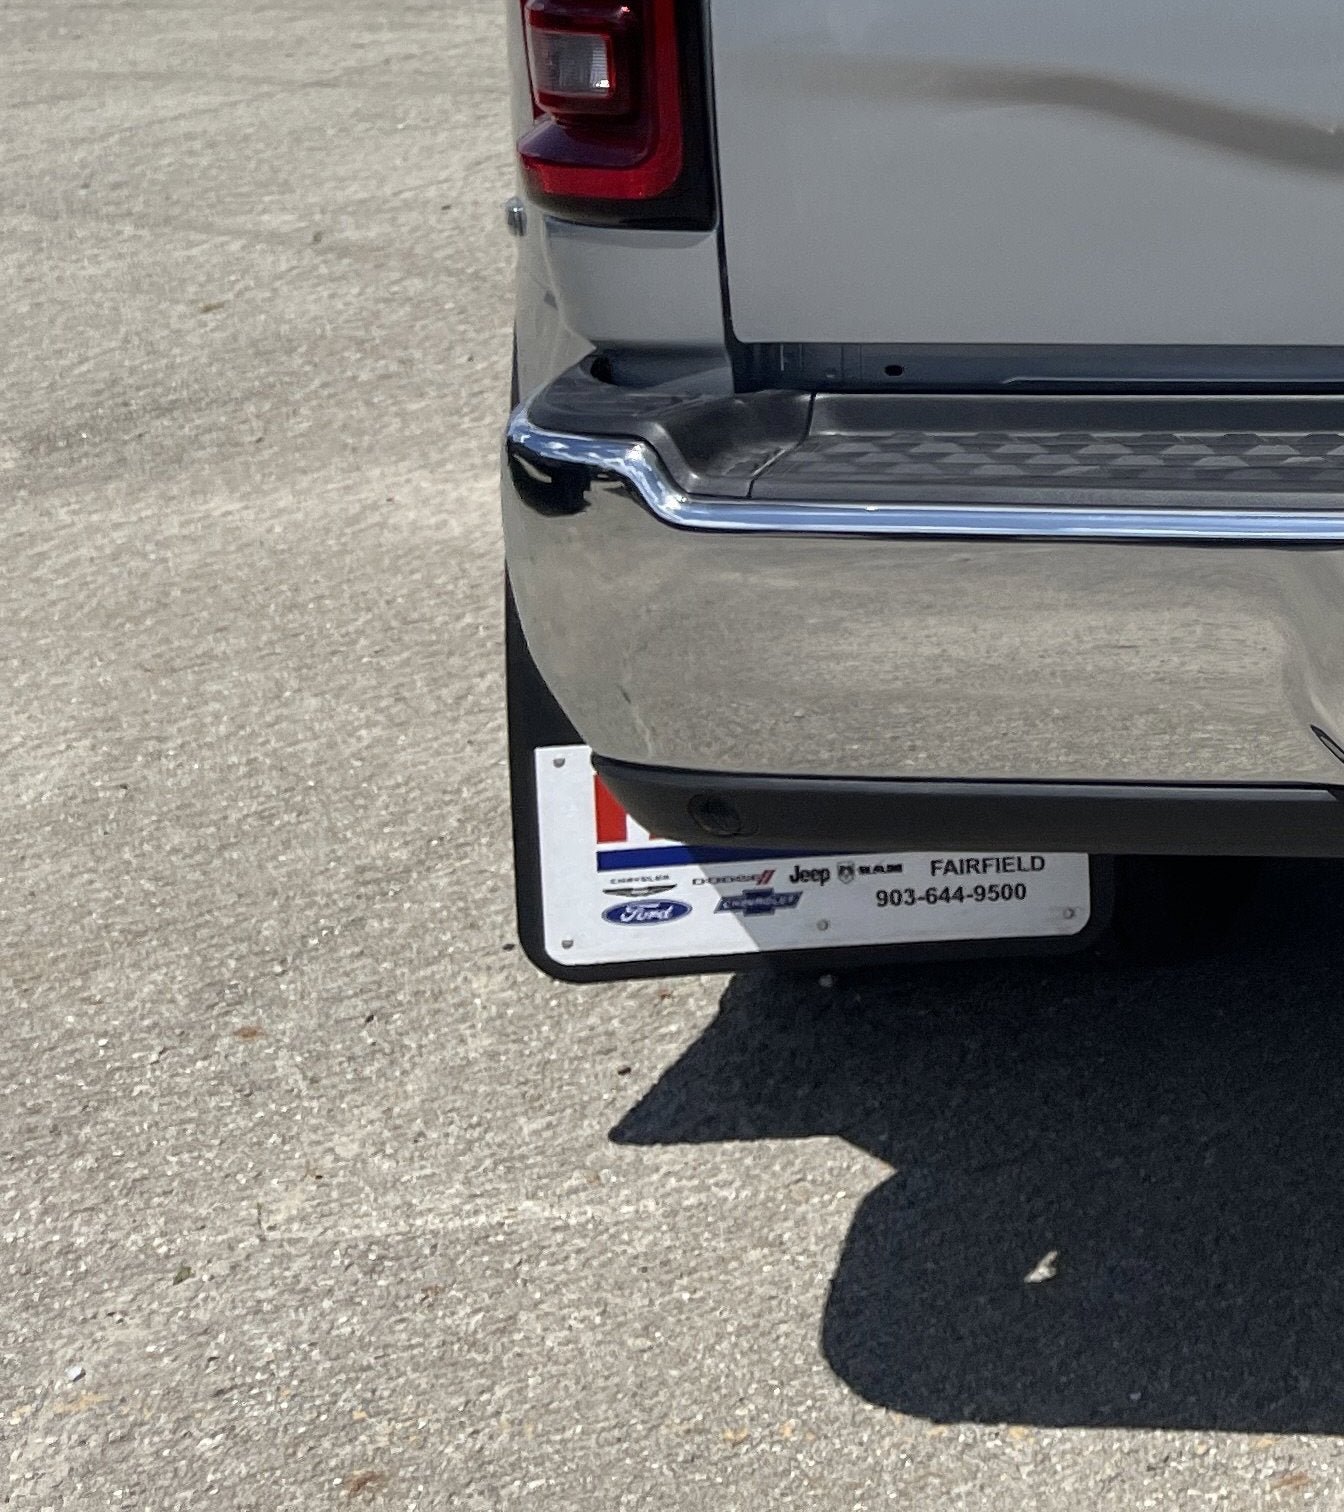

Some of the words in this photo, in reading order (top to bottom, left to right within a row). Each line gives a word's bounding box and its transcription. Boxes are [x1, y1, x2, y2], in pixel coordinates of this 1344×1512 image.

[789, 865, 831, 886] Jeep
[930, 856, 1046, 877] FAIRFIELD
[876, 882, 1027, 908] 903-644-9500
